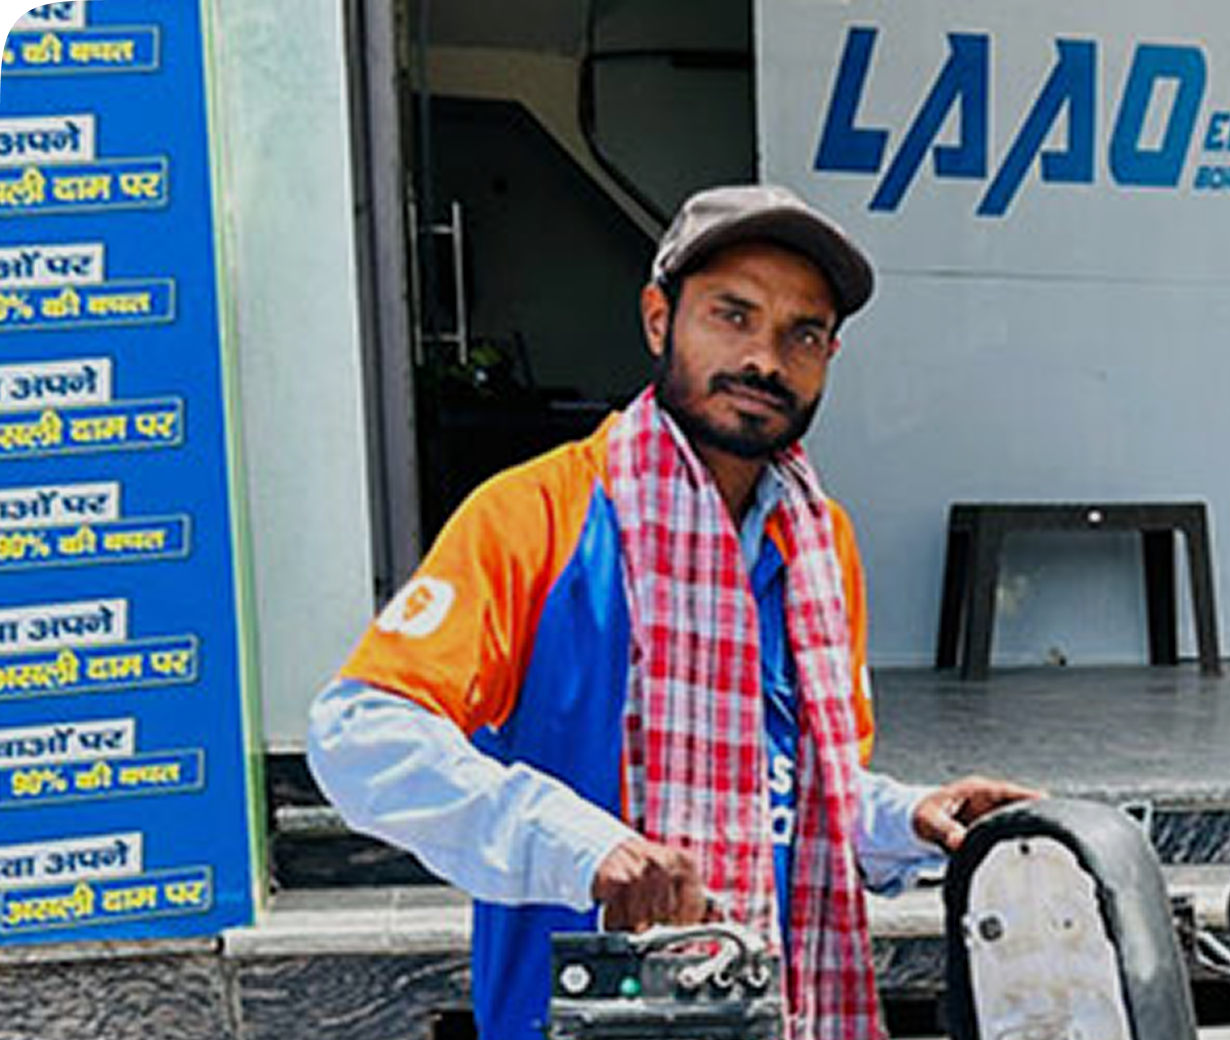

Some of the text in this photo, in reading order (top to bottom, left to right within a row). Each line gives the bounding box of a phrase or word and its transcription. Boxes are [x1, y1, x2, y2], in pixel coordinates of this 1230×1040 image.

[813, 26, 1207, 216] LAAO
[53, 175, 111, 200] दाम
[119, 173, 161, 197] पर
[46, 255, 92, 277] पर
[10, 365, 97, 399] अपने
[71, 414, 127, 442] दाम
[135, 412, 176, 440] पर
[62, 494, 108, 515] पर
[27, 603, 113, 641] अपने
[88, 653, 143, 679] दाम
[151, 650, 189, 674] पर
[78, 731, 124, 749] पर
[44, 840, 129, 875] अपने
[7, 880, 202, 924] असली दाम पर
